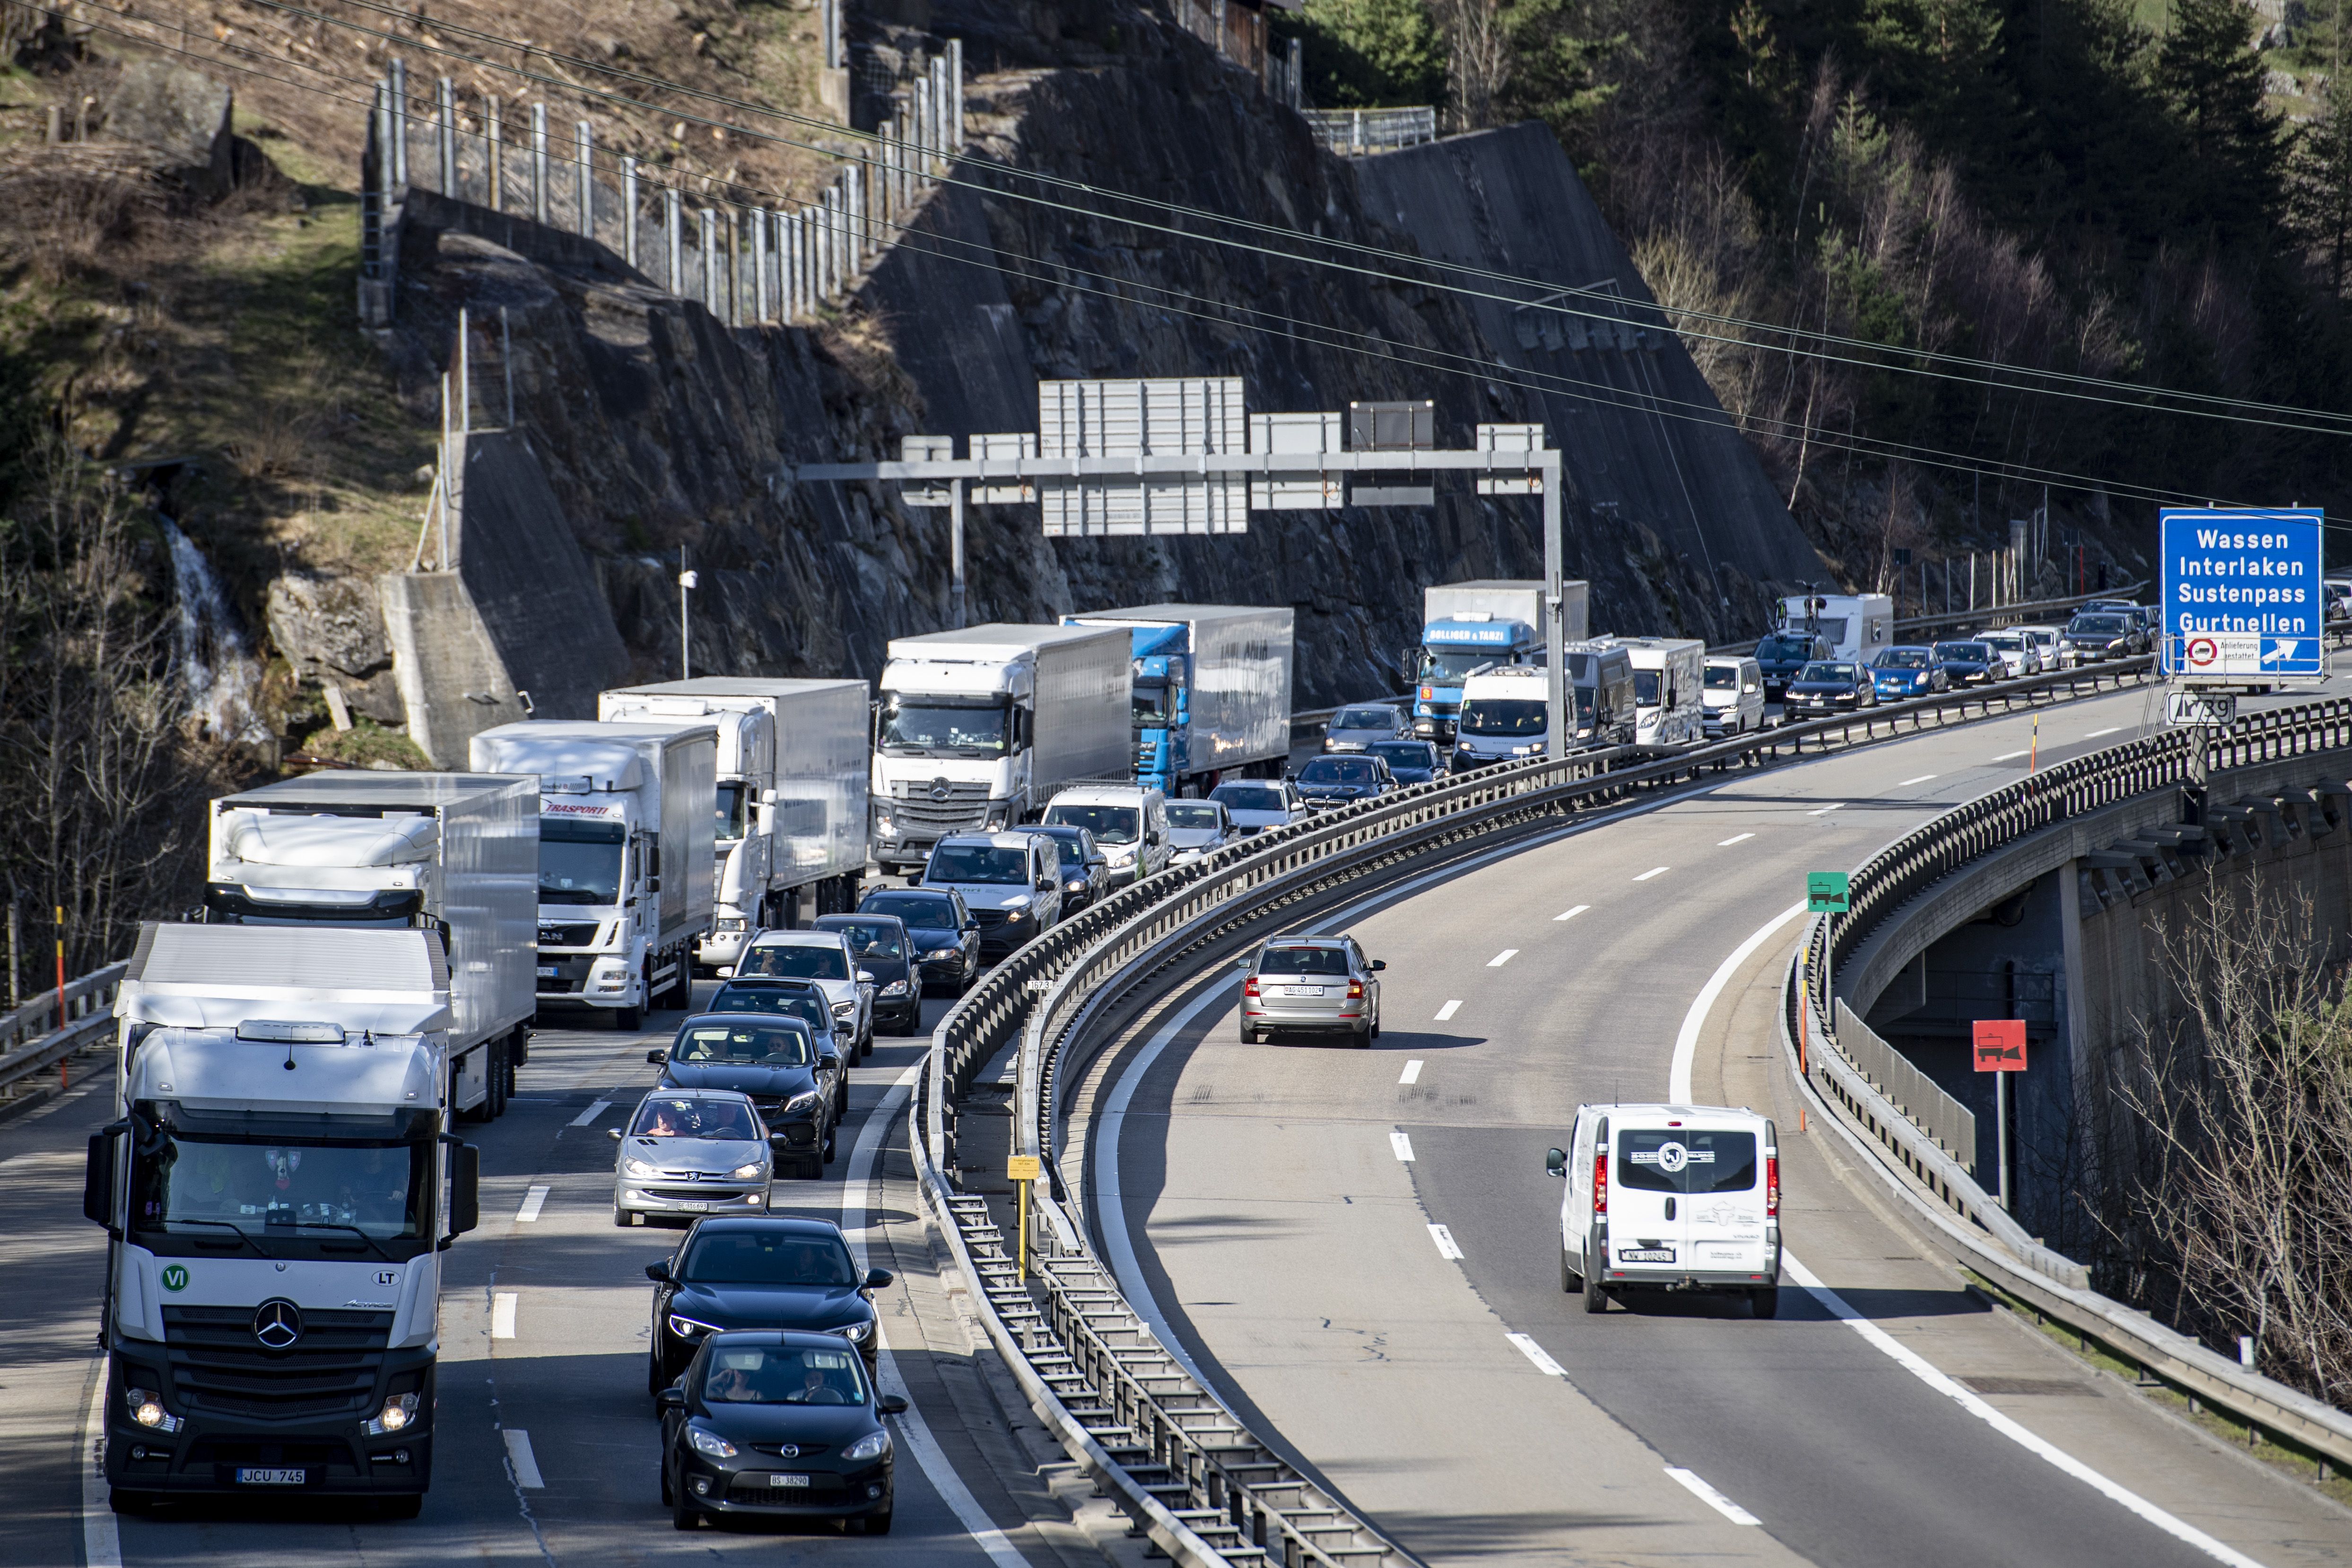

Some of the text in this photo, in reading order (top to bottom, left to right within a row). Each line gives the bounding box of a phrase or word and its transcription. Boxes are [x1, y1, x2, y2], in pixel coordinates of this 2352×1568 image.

[2197, 529, 2288, 549] Wassen
[2180, 557, 2303, 576] Interlaken
[2178, 583, 2305, 607] Sustenpass
[2179, 612, 2305, 632] Gurtnellen
[1479, 631, 1504, 641] TANZI
[2221, 642, 2258, 651] Anlieferung
[2204, 699, 2228, 717] 39
[545, 804, 609, 815] TRASPORTI
[539, 932, 563, 941] AN
[1031, 981, 1049, 989] 167.3
[166, 1271, 184, 1286] VI
[379, 1272, 395, 1284] LT
[244, 1471, 303, 1482] JCU 745
[772, 1475, 807, 1485] BS 38290
